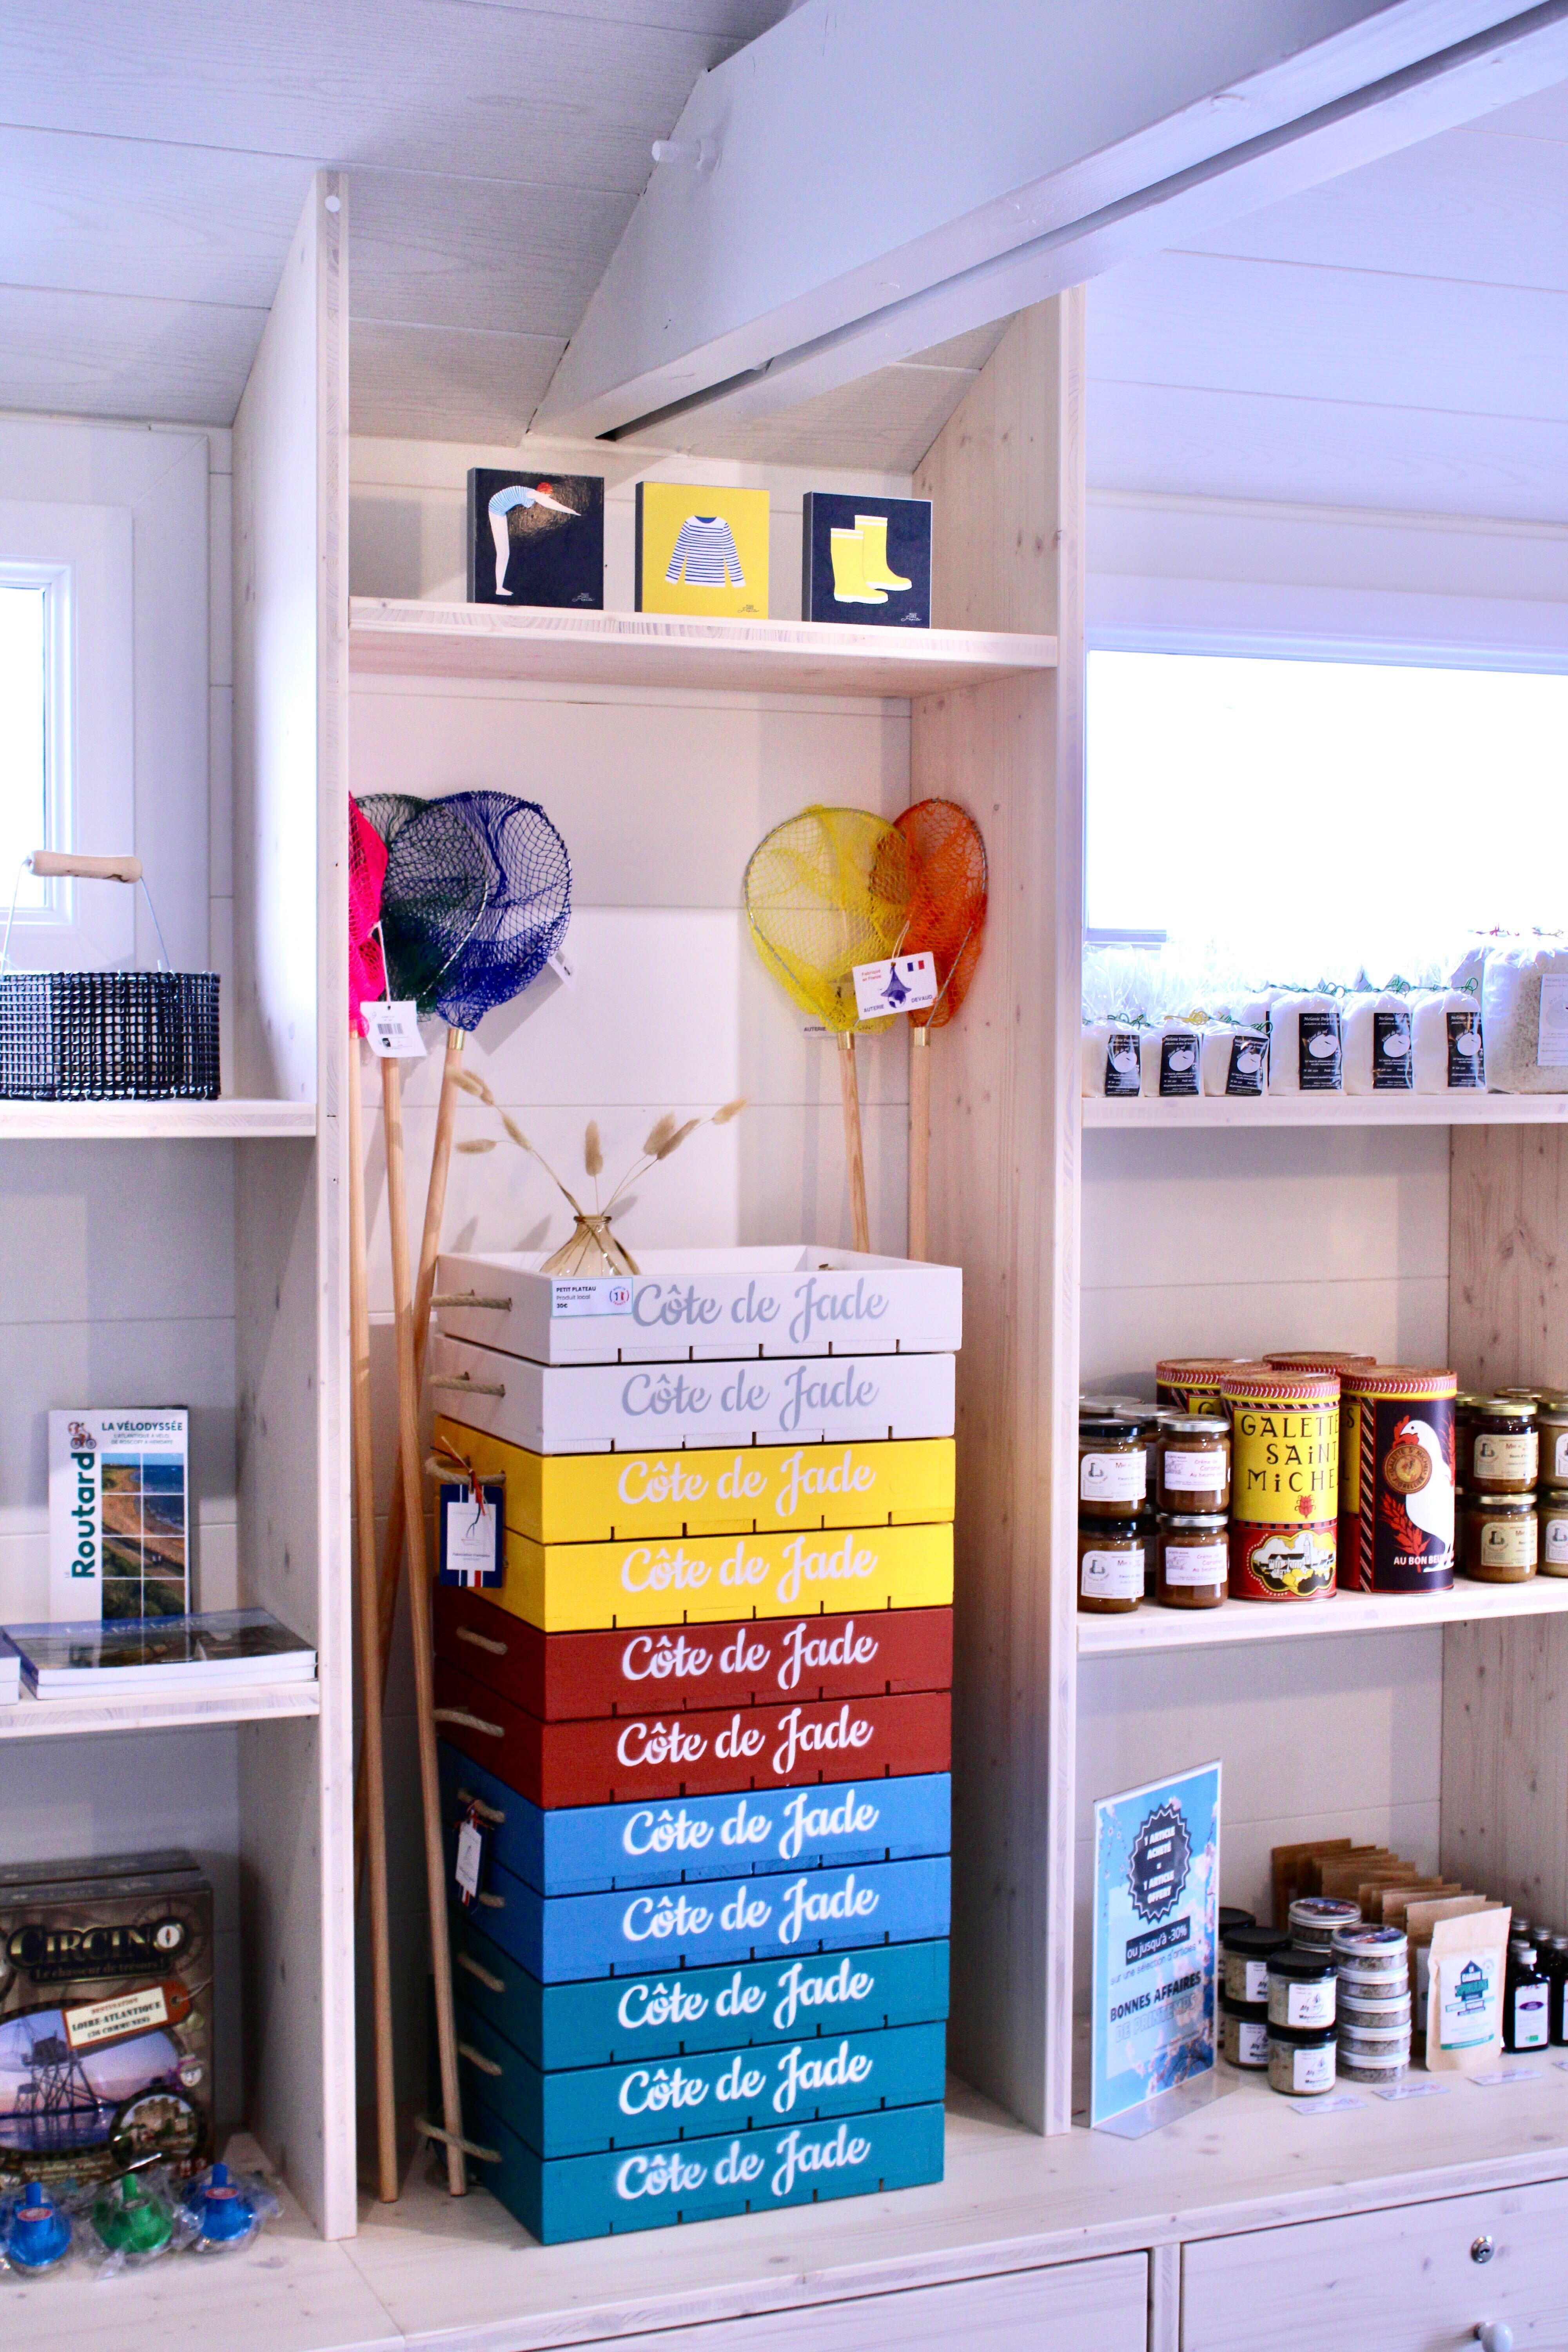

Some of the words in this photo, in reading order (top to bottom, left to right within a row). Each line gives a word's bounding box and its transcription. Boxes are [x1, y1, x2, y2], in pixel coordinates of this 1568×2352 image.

[864, 1004, 884, 1013] AUTERIE
[911, 995, 933, 1003] DEVAUD
[633, 1284, 722, 1327] Côte
[731, 1281, 780, 1323] de
[789, 1277, 889, 1343] Jade
[622, 1374, 712, 1416] Côte
[721, 1369, 770, 1411] de
[779, 1365, 879, 1431] Jade
[102, 1423, 114, 1431] LA
[116, 1420, 183, 1431] VÉLODYSSÉE
[618, 1461, 708, 1504] Côte
[717, 1455, 767, 1499] de
[776, 1450, 876, 1517] Jade
[1247, 1468, 1339, 1493] MiCHE
[71, 1452, 95, 1577] Routard
[621, 1548, 711, 1592] Côte
[720, 1541, 769, 1585] de
[777, 1534, 877, 1603] Jade
[1394, 1557, 1407, 1565] AU
[1408, 1556, 1427, 1565] BON
[622, 1635, 712, 1680] Côte
[720, 1628, 770, 1673] de
[778, 1621, 878, 1690] Jade
[617, 1722, 707, 1767] Côte
[715, 1714, 765, 1758] de
[773, 1705, 873, 1774] Jade
[623, 1809, 713, 1855] Côte
[722, 1800, 771, 1845] de
[779, 1789, 879, 1859] Jade
[1144, 1836, 1148, 1846] 1
[1149, 1826, 1175, 1844] ARTICLE
[1147, 1841, 1172, 1860] ACHETÉ
[1143, 1881, 1147, 1891] 1
[1149, 1870, 1174, 1889] ARTICLE
[1147, 1886, 1172, 1904] OFFERT
[623, 1895, 713, 1941] Côte
[721, 1886, 771, 1930] de
[779, 1874, 878, 1944] Jade
[1111, 1975, 1121, 1985] sur
[1123, 1969, 1135, 1980] une
[1137, 1955, 1166, 1974] sélection
[1167, 1943, 1196, 1961] d'articles
[1127, 1947, 1138, 1959] ou
[1139, 1932, 1167, 1958] jusqu'à
[1168, 1924, 1188, 1942] -30%
[72, 2002, 161, 2032] LOIRE-ATLANTIQUE
[618, 1982, 708, 2028] Côte
[716, 1971, 766, 2016] de
[773, 1958, 874, 2029] Jade
[1110, 1992, 1151, 2023] BONNES
[1154, 1971, 1201, 2004] AFFAIRES
[1116, 2021, 1131, 2043] DE
[1133, 1993, 1196, 2035] PRINTEMPS
[619, 2067, 708, 2114] Côte
[716, 2056, 766, 2102] de
[773, 2041, 872, 2113] Jade
[617, 2152, 707, 2199] Côte
[714, 2140, 764, 2185] de
[771, 2124, 871, 2196] Jade
